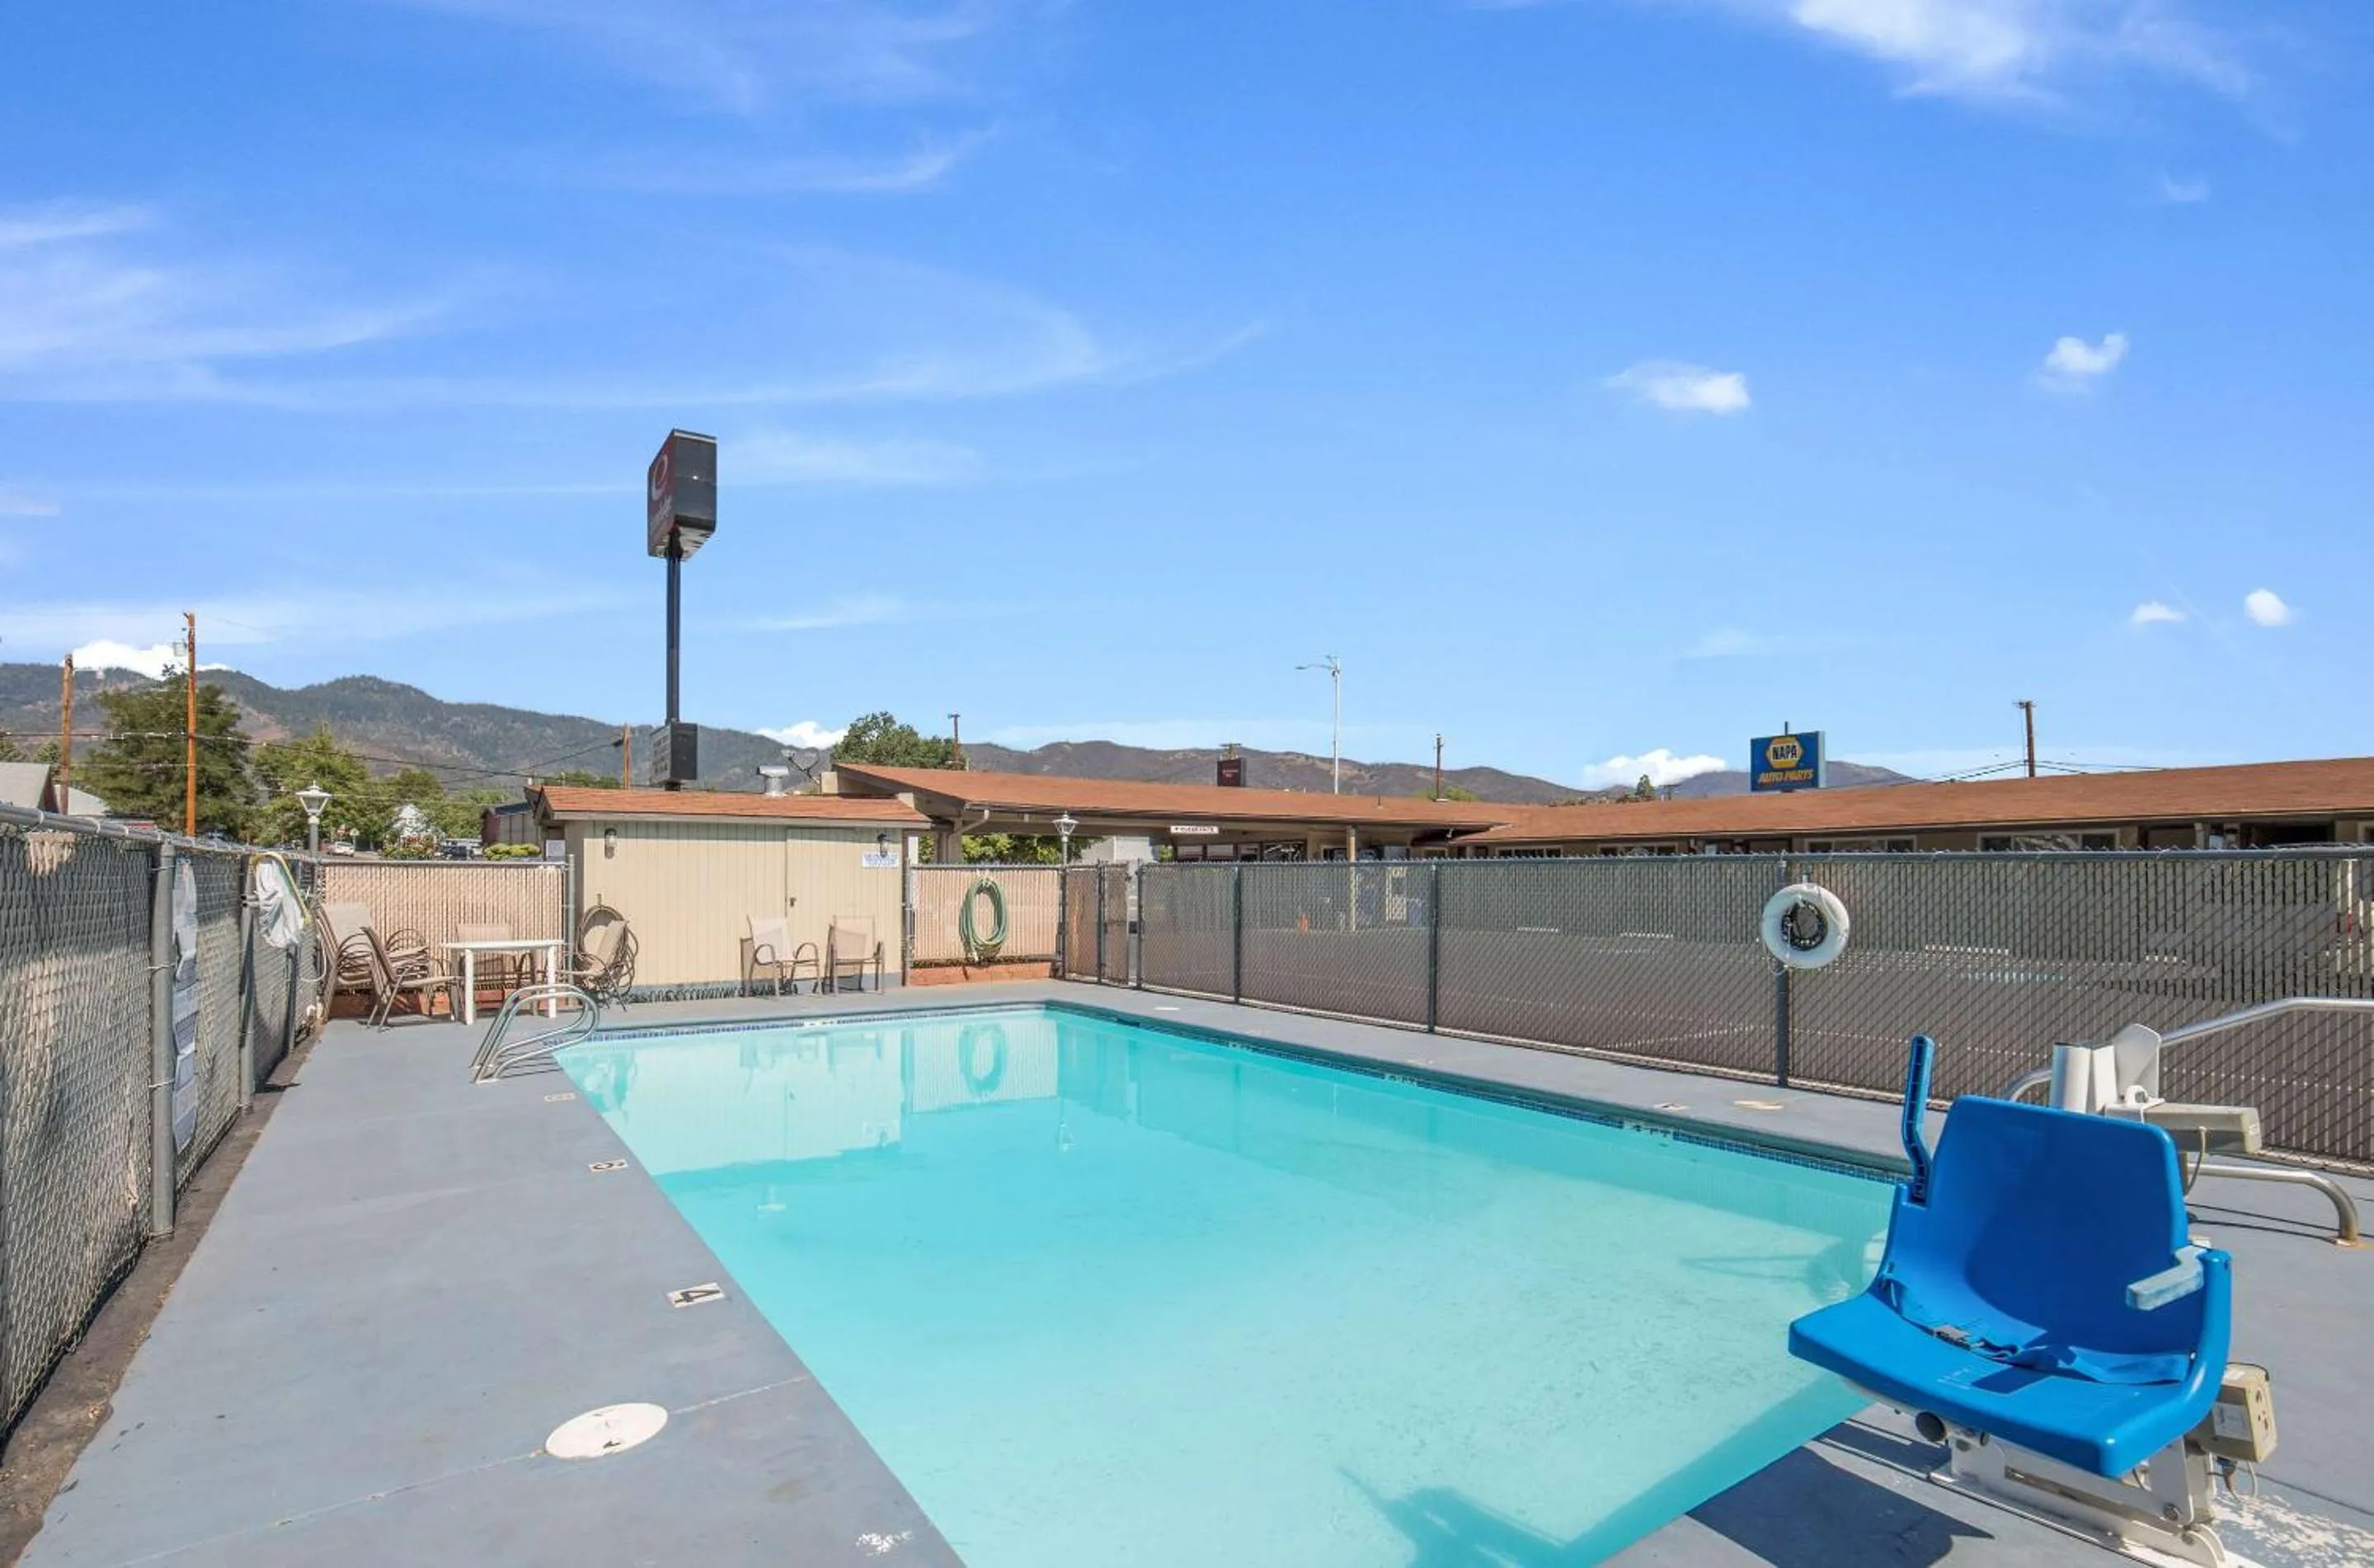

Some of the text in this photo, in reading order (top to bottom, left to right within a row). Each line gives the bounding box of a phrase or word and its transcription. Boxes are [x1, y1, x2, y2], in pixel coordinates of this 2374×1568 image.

[1772, 744, 1798, 760] NAPA
[1758, 768, 1814, 785] AUTO PARTS
[674, 1289, 721, 1303] 4
